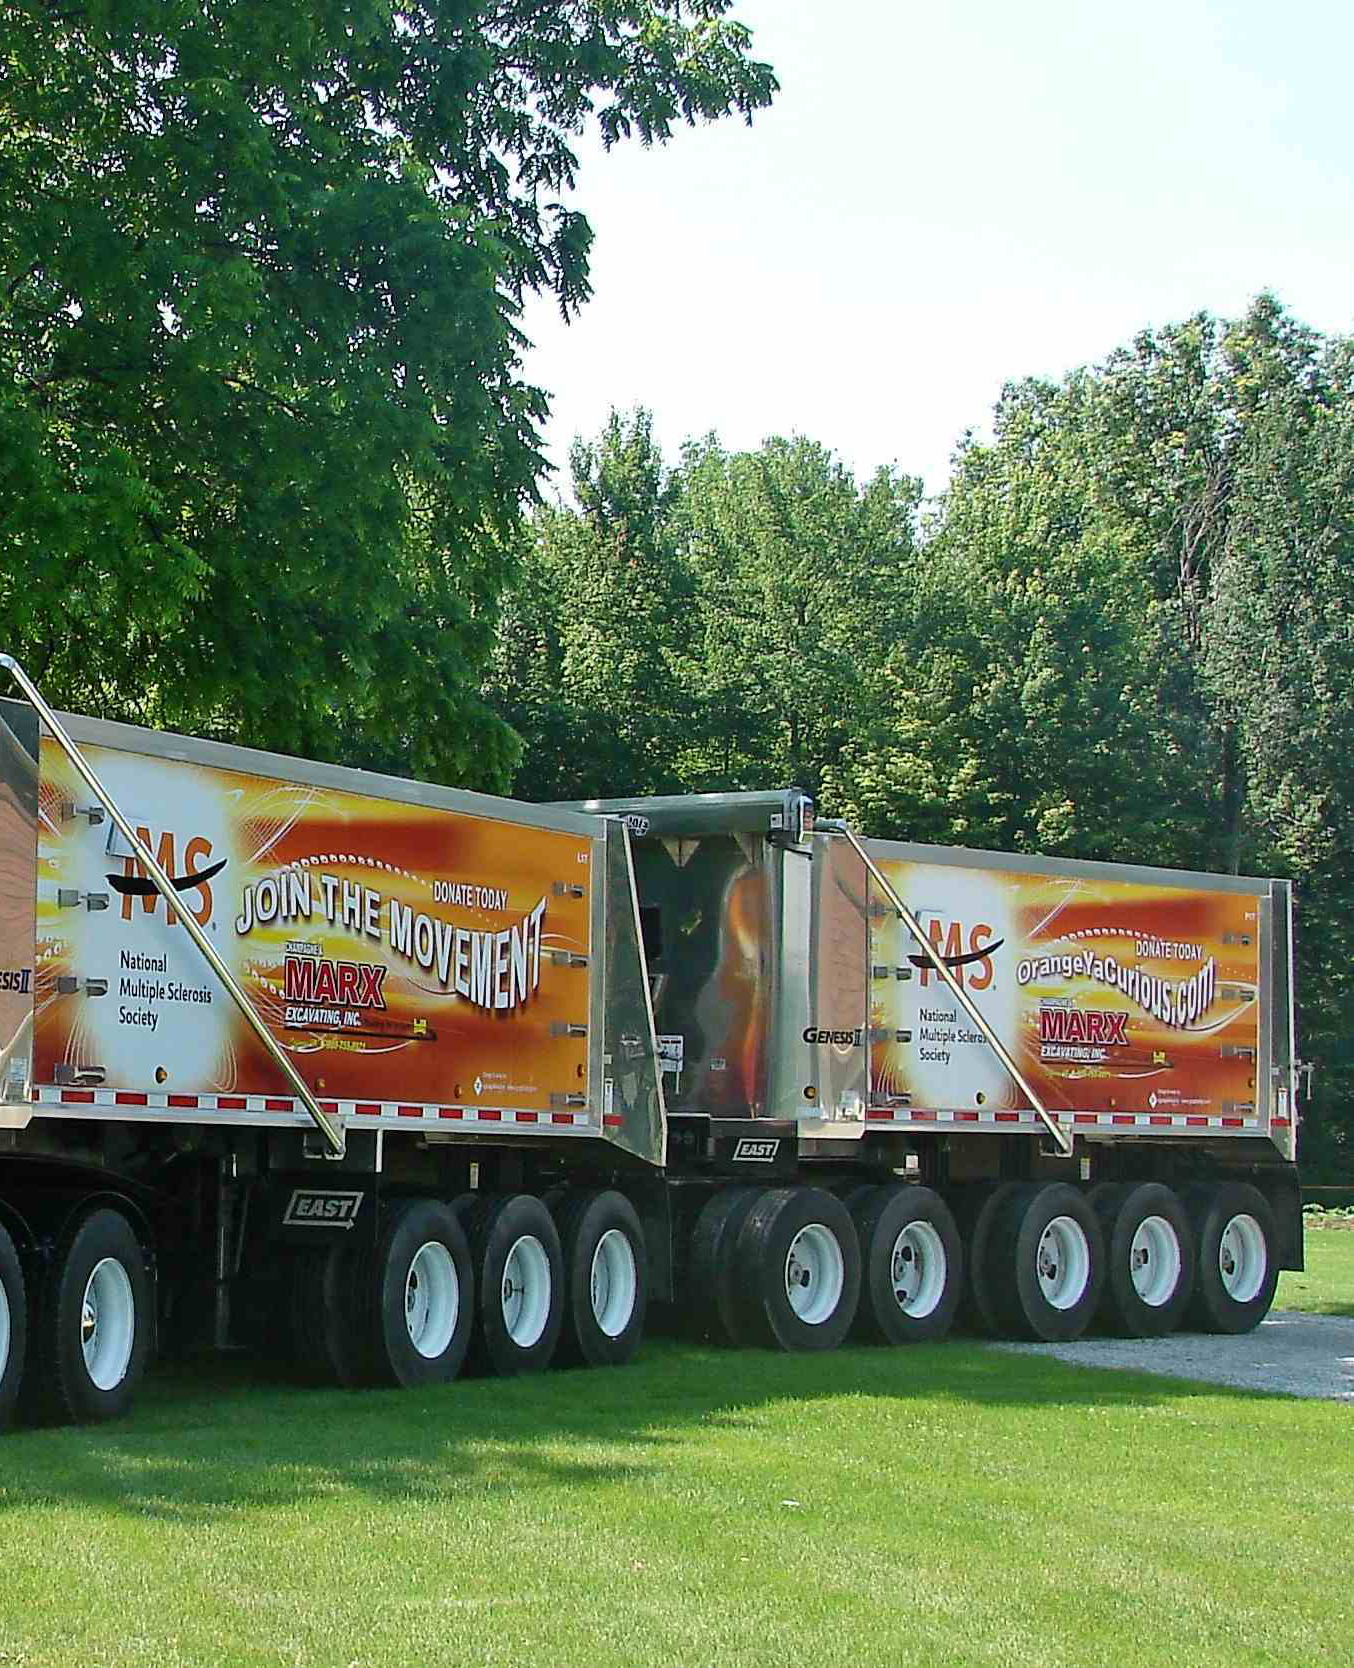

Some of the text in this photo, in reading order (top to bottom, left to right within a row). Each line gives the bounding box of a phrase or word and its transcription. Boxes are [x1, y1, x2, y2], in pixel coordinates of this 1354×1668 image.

[111, 827, 213, 926] MS
[433, 879, 508, 911] DONATE TODAY
[236, 871, 547, 1009] JOIN THE MOVEMENT
[1136, 940, 1202, 961] DONATE TODAY
[120, 950, 167, 973] National
[918, 919, 994, 991] MS
[119, 976, 212, 1004] Multiple Sclerosis
[285, 957, 387, 1010] MARX
[1017, 950, 1216, 1027] OrangeYaCurious.com
[118, 1005, 158, 1031] Society
[285, 1007, 362, 1026] EXCAVATING, INC.
[919, 1008, 957, 1023] National
[1040, 1009, 1128, 1046] MARX
[803, 1027, 854, 1044] GENESIS
[919, 1028, 956, 1046] Multiple
[919, 1047, 951, 1065] Society
[740, 1144, 774, 1156] EAST
[296, 1199, 354, 1217] EAST
